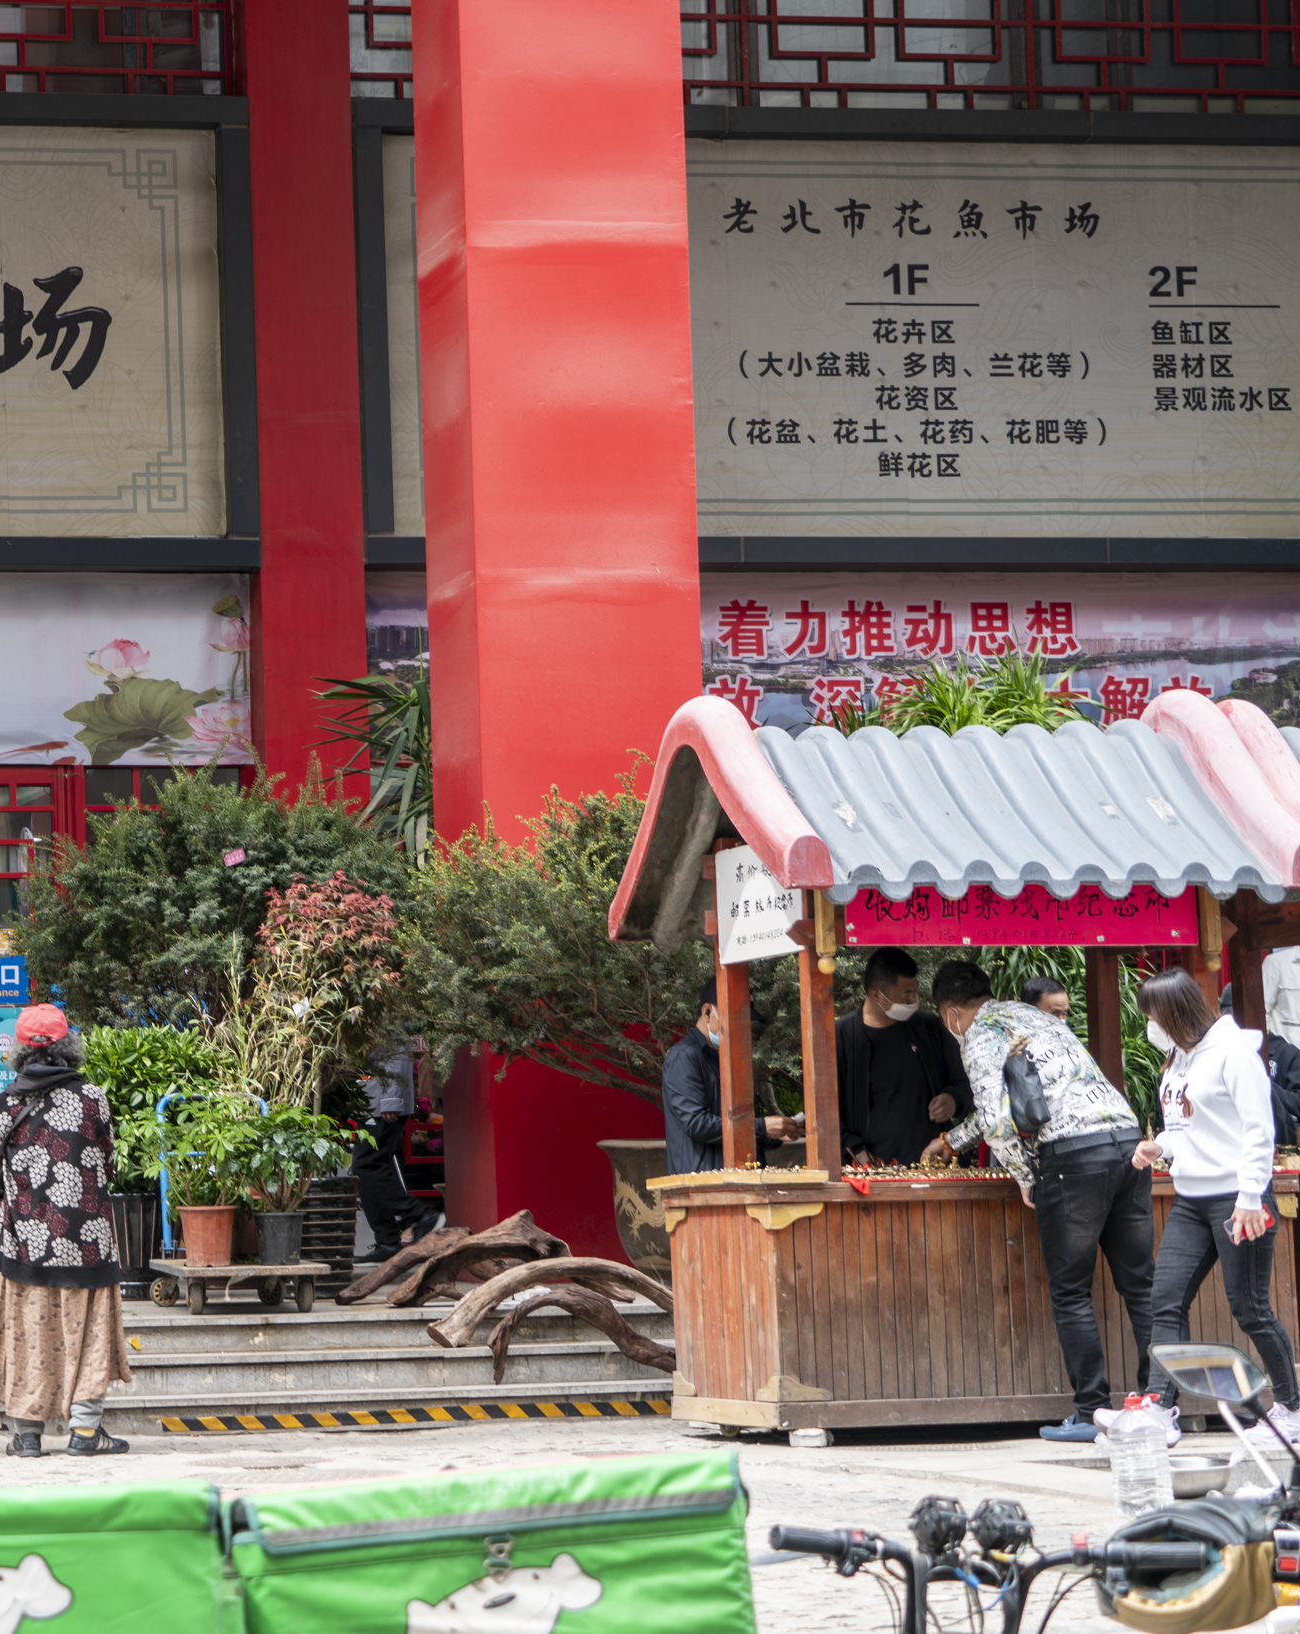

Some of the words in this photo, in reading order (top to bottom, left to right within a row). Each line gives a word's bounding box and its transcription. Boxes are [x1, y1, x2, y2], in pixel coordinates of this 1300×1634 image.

[723, 197, 1100, 239] 老北市花魚市场
[883, 263, 930, 296] 1F
[1148, 265, 1198, 298] 2F
[872, 318, 956, 344] 花卉区
[1150, 320, 1233, 345] 鱼缸区
[1152, 353, 1234, 379] 器材区
[875, 385, 959, 411] 花资区
[1153, 387, 1292, 412] 景观流水区
[877, 452, 961, 478] 鲜花区
[718, 599, 1080, 658] 着力推动思想
